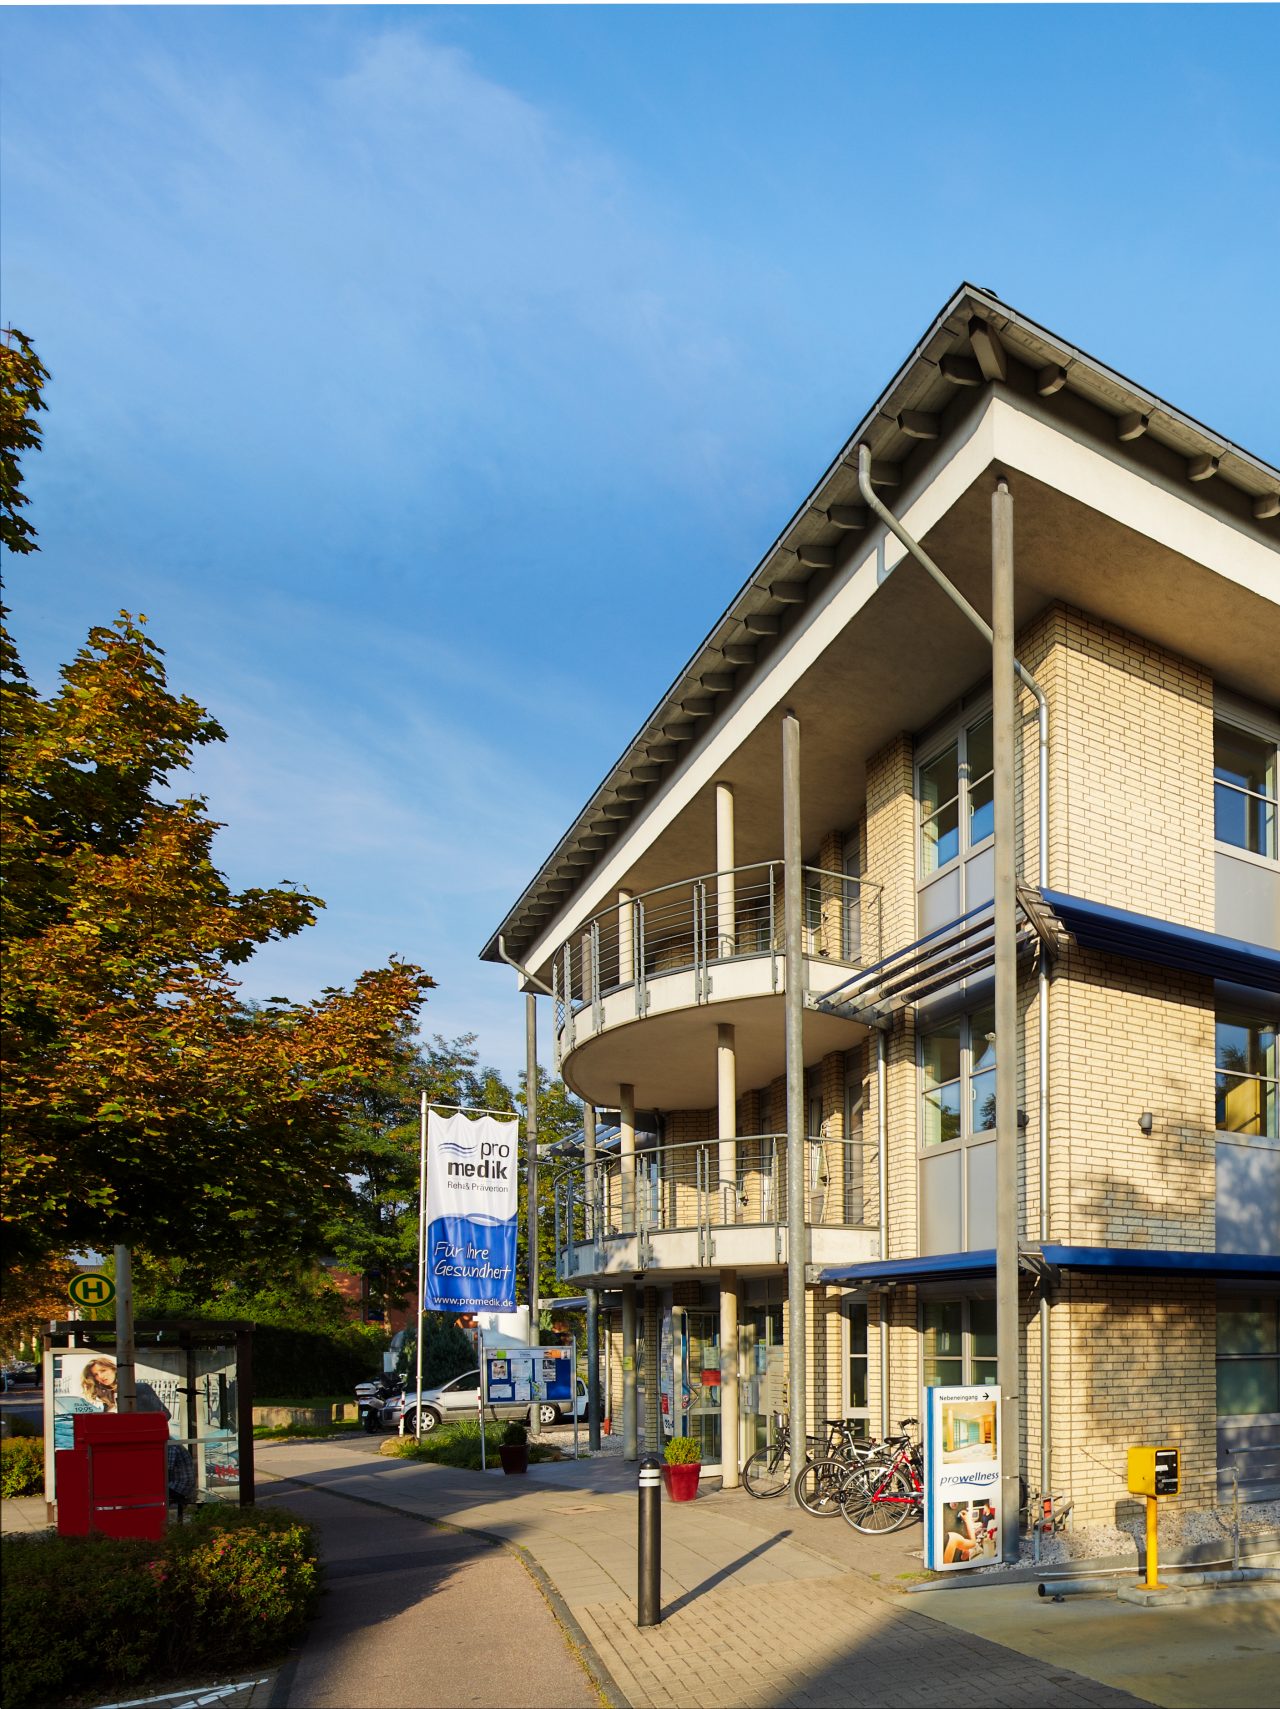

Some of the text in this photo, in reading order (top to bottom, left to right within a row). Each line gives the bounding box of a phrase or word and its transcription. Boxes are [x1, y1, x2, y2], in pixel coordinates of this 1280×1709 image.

[481, 1142, 510, 1160] pro
[447, 1160, 508, 1179] medik
[435, 1241, 489, 1260] Für Ihre
[434, 1259, 512, 1280] Gesundheit
[82, 1281, 103, 1299] H
[433, 1296, 513, 1307] www.promedik.de
[940, 1472, 999, 1486] prowellness
